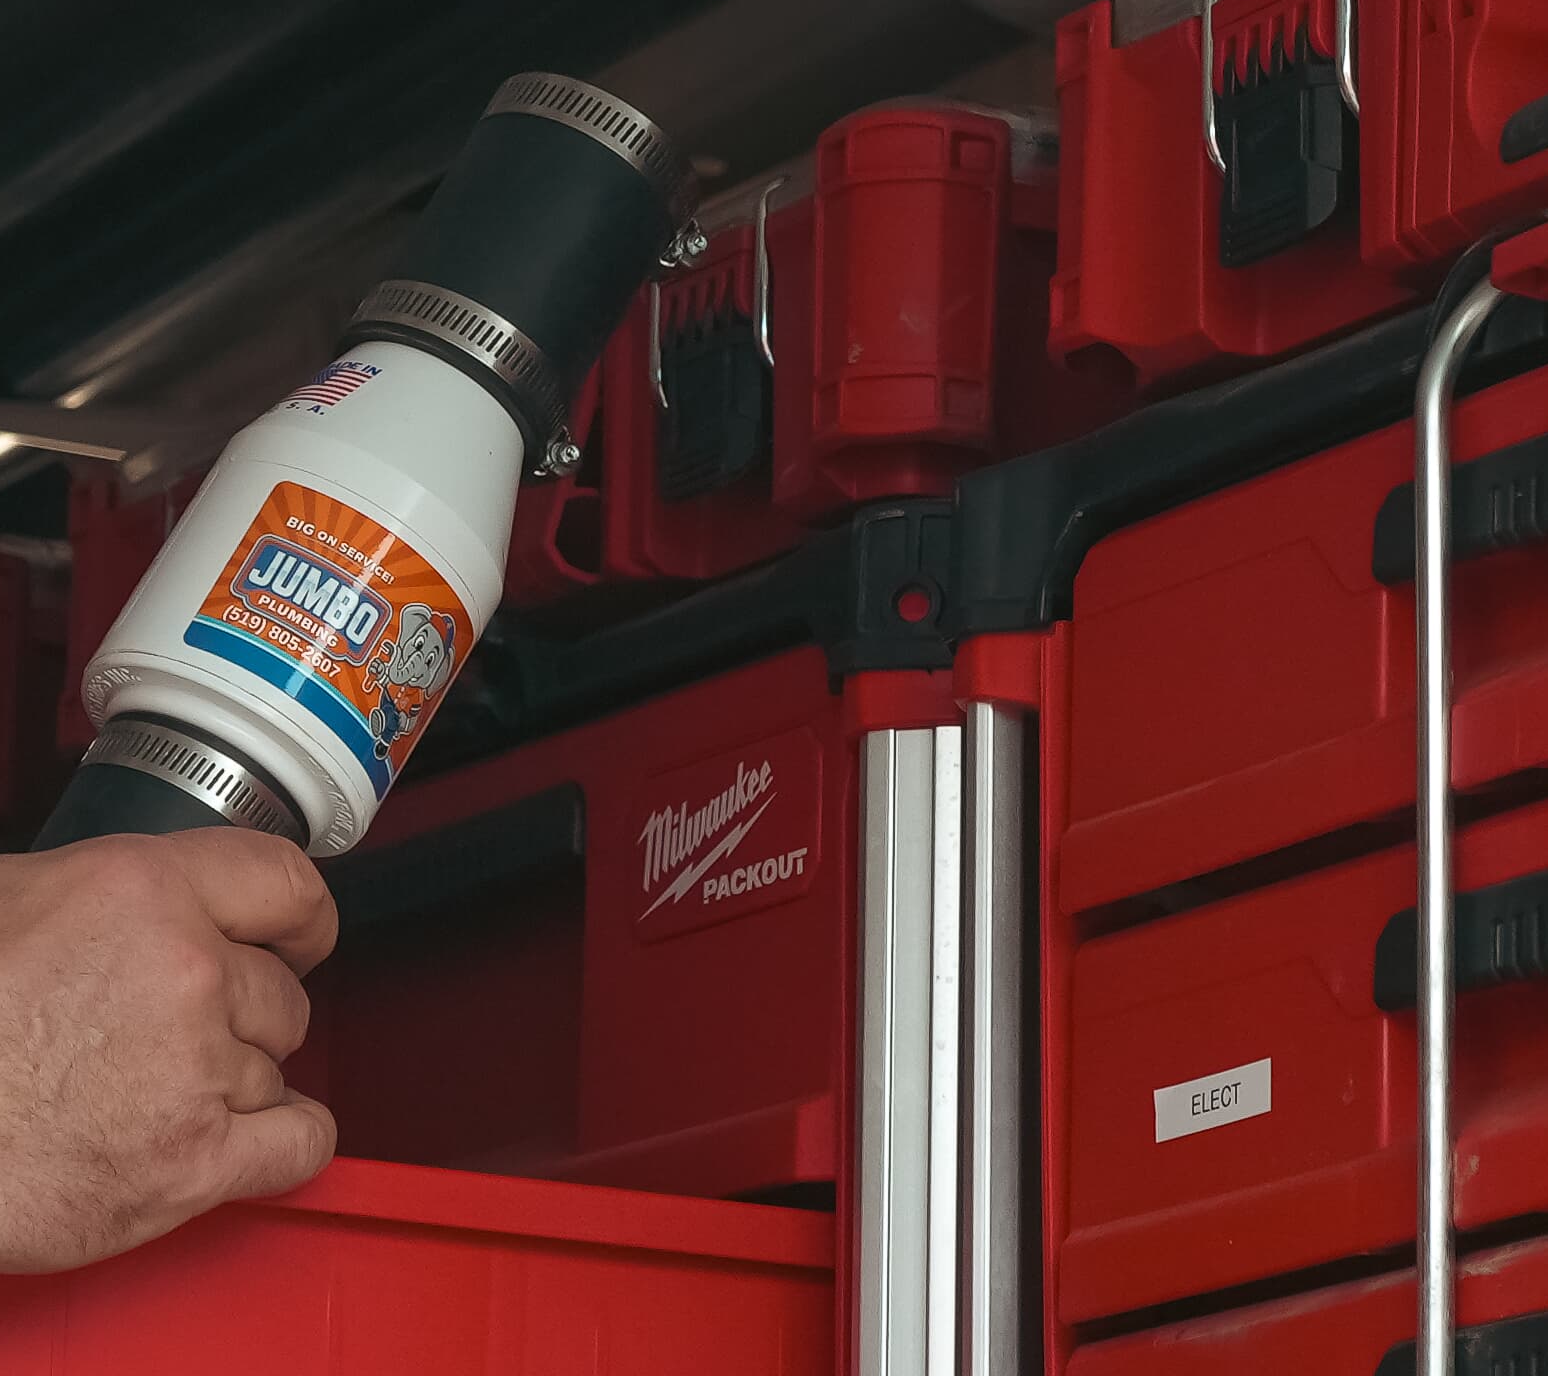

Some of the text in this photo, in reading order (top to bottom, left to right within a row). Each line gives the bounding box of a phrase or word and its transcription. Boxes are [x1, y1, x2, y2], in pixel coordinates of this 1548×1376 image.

[361, 364, 383, 377] IN
[285, 515, 396, 586] BIG ON SERVICE!
[246, 549, 381, 647] JUMBO
[257, 594, 340, 648] PLUMBING
[221, 604, 342, 678] (519) 805-2607
[636, 759, 775, 893] Milwaukee
[702, 846, 809, 905] PACKOUT
[1190, 1081, 1243, 1117] ELECT
